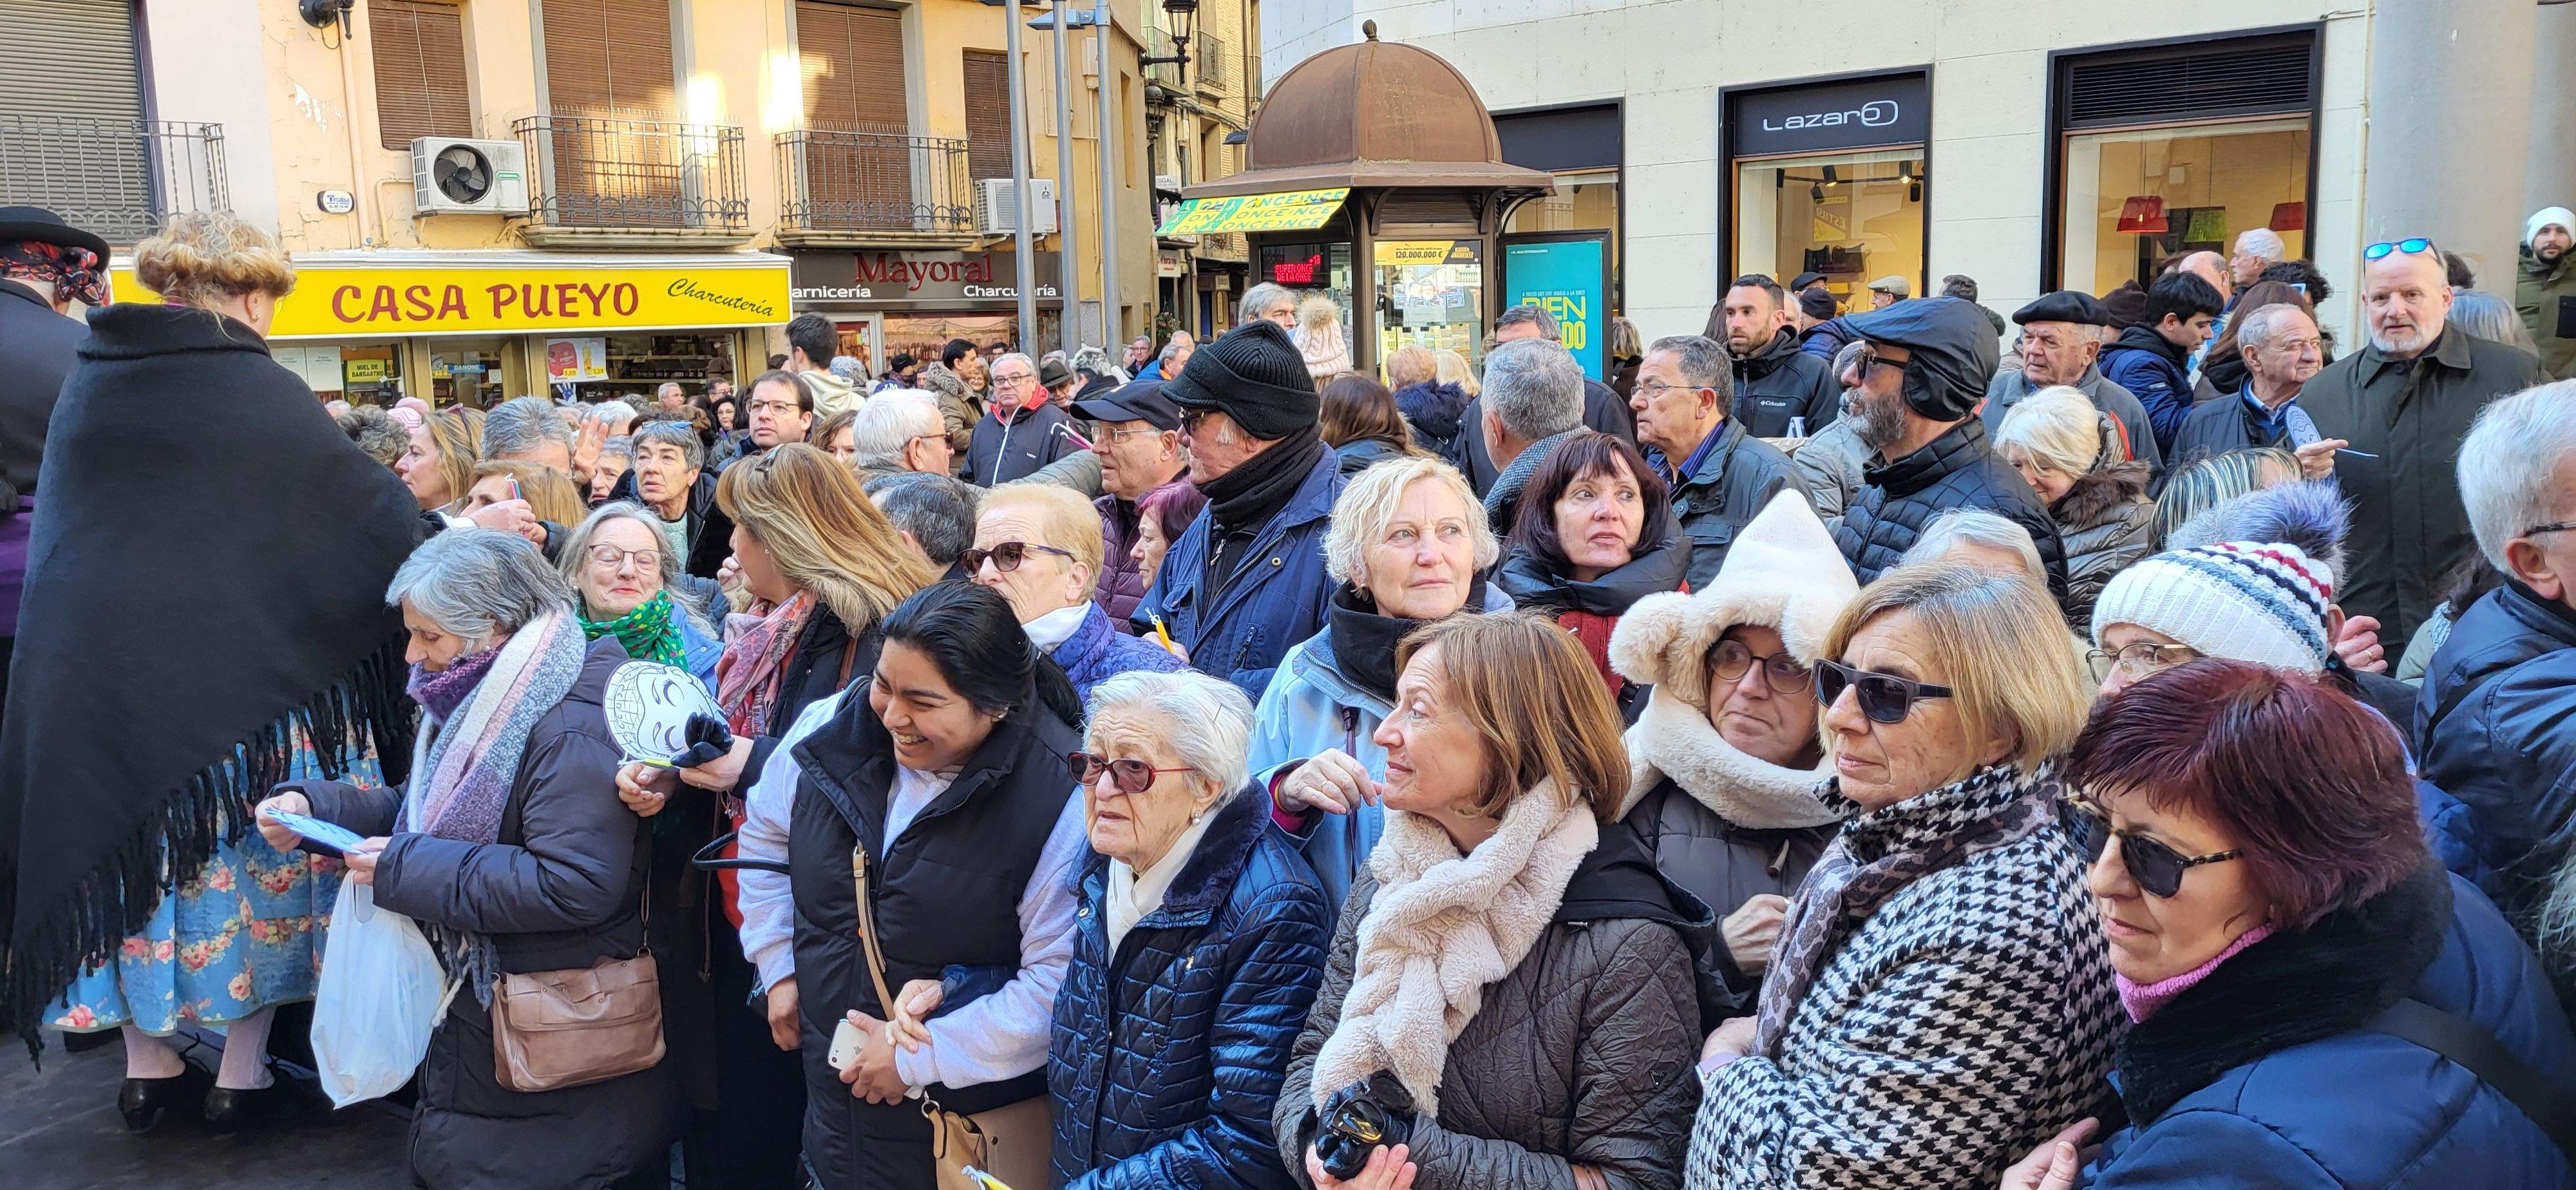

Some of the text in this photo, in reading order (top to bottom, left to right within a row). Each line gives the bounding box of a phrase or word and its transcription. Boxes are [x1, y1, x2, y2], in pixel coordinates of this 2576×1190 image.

[1763, 100, 1899, 131] Lazaro
[853, 252, 994, 291] Mayoral
[1275, 264, 1312, 273] SUPER ONCE
[1296, 273, 1311, 281] ONCE
[332, 282, 638, 323] CASA PUEYO
[667, 278, 773, 316] Charcutería
[792, 284, 872, 298] arnicería
